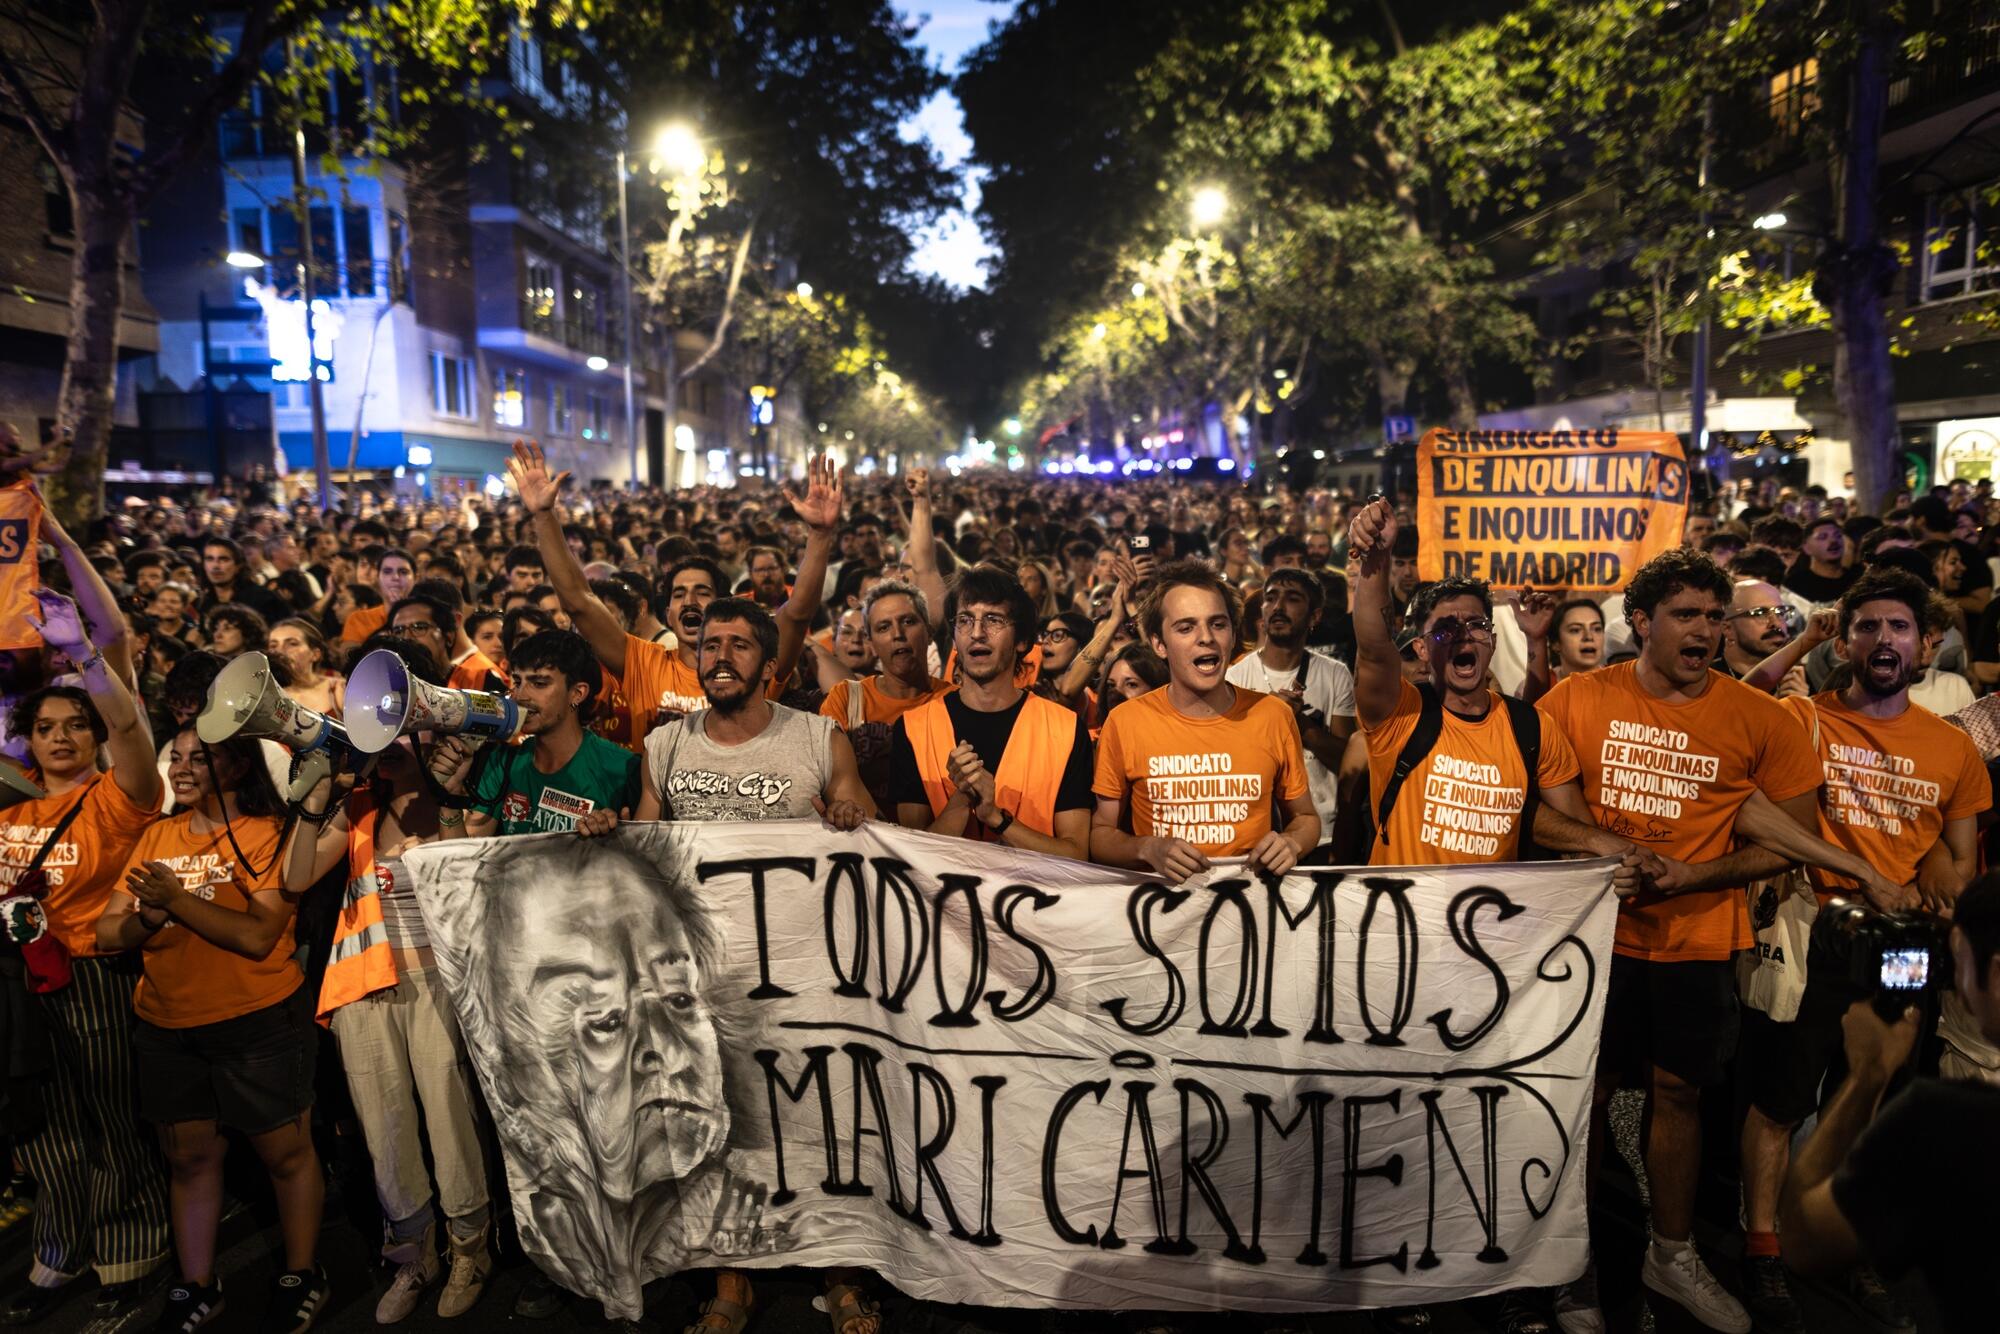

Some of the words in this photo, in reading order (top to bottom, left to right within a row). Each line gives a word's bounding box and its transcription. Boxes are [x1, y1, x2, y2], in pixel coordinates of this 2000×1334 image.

[1391, 420, 1408, 441] P
[1442, 458, 1485, 492] DE
[1492, 457, 1683, 498] INQUILINAS
[1444, 506, 1460, 540] E
[1469, 506, 1649, 544] INQUILINOS
[1443, 551, 1483, 580] DE
[1490, 552, 1621, 586] MADRID
[1609, 720, 1688, 751] SINDICATO
[1148, 752, 1232, 777] SINDICATO
[1433, 754, 1501, 785] SINDICATO
[1605, 743, 1626, 763] DE
[1628, 746, 1715, 778] INQUILINAS
[1829, 743, 1915, 775] SINDICATO
[544, 789, 580, 807] IZQUIERDA
[1150, 781, 1168, 800] DE
[1172, 778, 1259, 800] INQUILINAS
[1428, 779, 1449, 800] DE
[1450, 783, 1522, 810] INQUILINAS
[1602, 767, 1612, 785] E
[1613, 768, 1700, 800] INQUILINOS
[1827, 766, 1848, 783] DE
[1850, 769, 1936, 802] INQUILINAS
[1152, 804, 1160, 820] E
[1162, 802, 1248, 824] INQUILINOS
[1424, 802, 1434, 822] E
[1435, 805, 1512, 835] INQUILINOS
[1601, 787, 1618, 808] DE
[1619, 791, 1682, 820] MADRID
[1827, 787, 1835, 804] E
[1838, 788, 1920, 821] INQUILINOS
[1152, 821, 1169, 838] DE
[1172, 824, 1235, 844] MADRID
[1600, 808, 1635, 836] Nodo
[1826, 806, 1845, 824] DE
[1848, 808, 1902, 836] MADRID
[1420, 823, 1441, 847] DE
[1441, 830, 1499, 856] MADRID
[696, 852, 1061, 1029] TODOS
[1100, 868, 1527, 1053] SOMOS
[754, 1042, 1008, 1248] MARI
[1042, 1075, 1511, 1274] CARMEN
